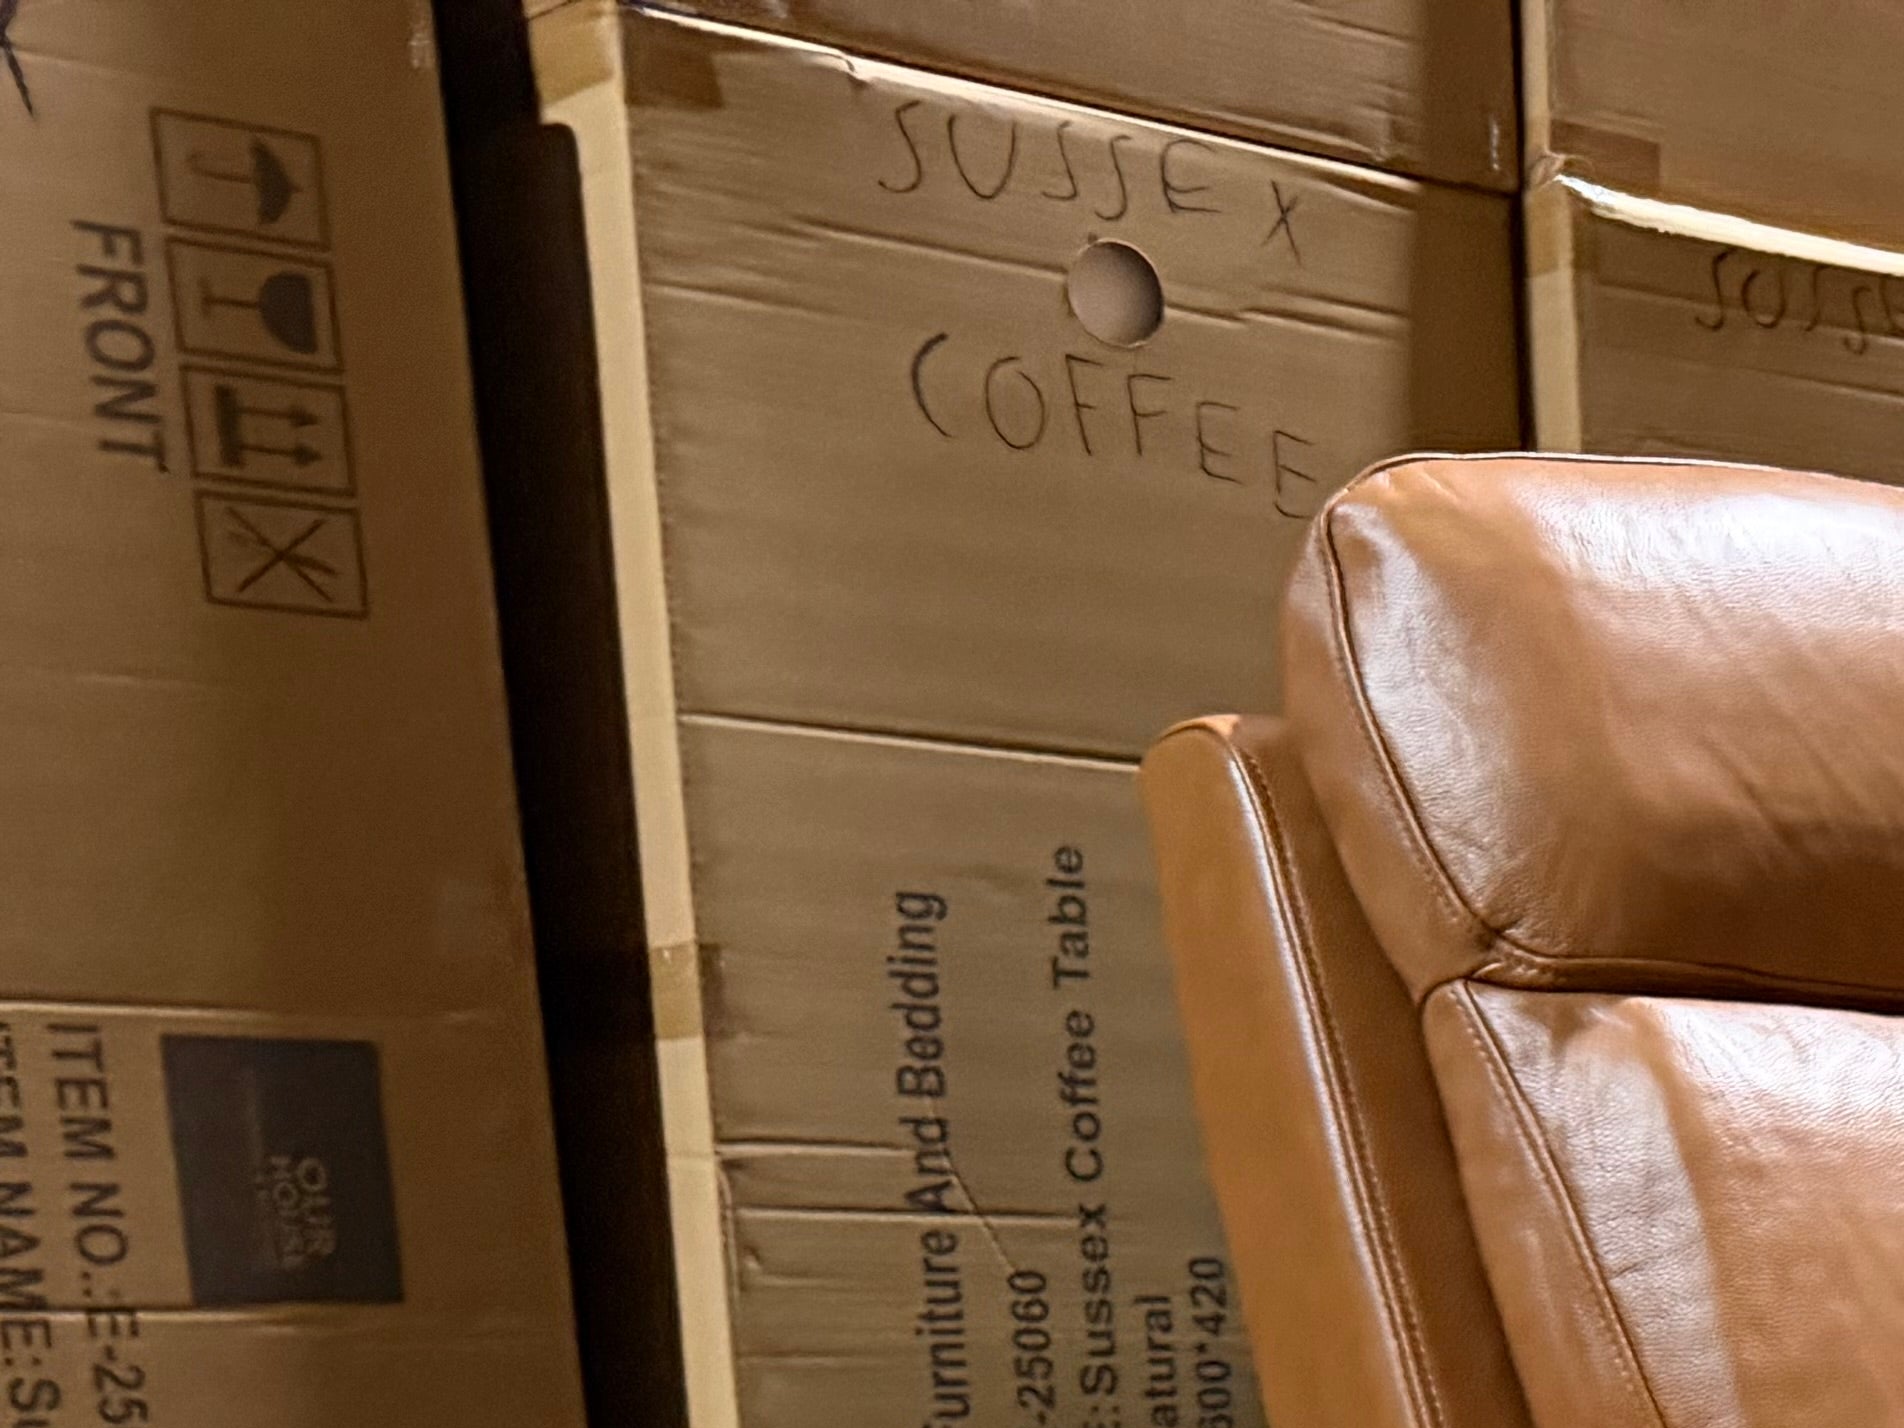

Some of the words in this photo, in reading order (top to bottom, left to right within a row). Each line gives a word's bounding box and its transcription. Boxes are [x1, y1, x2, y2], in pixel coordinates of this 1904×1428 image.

[878, 100, 1305, 266] SUSSEX
[70, 219, 171, 473] FRONT
[911, 332, 1320, 520] COFFEE
[886, 891, 947, 1098] Bedding
[1045, 846, 1090, 991] Table
[47, 1022, 116, 1162] ITEM
[899, 1117, 953, 1213] And
[1057, 1010, 1104, 1183] Coffee
